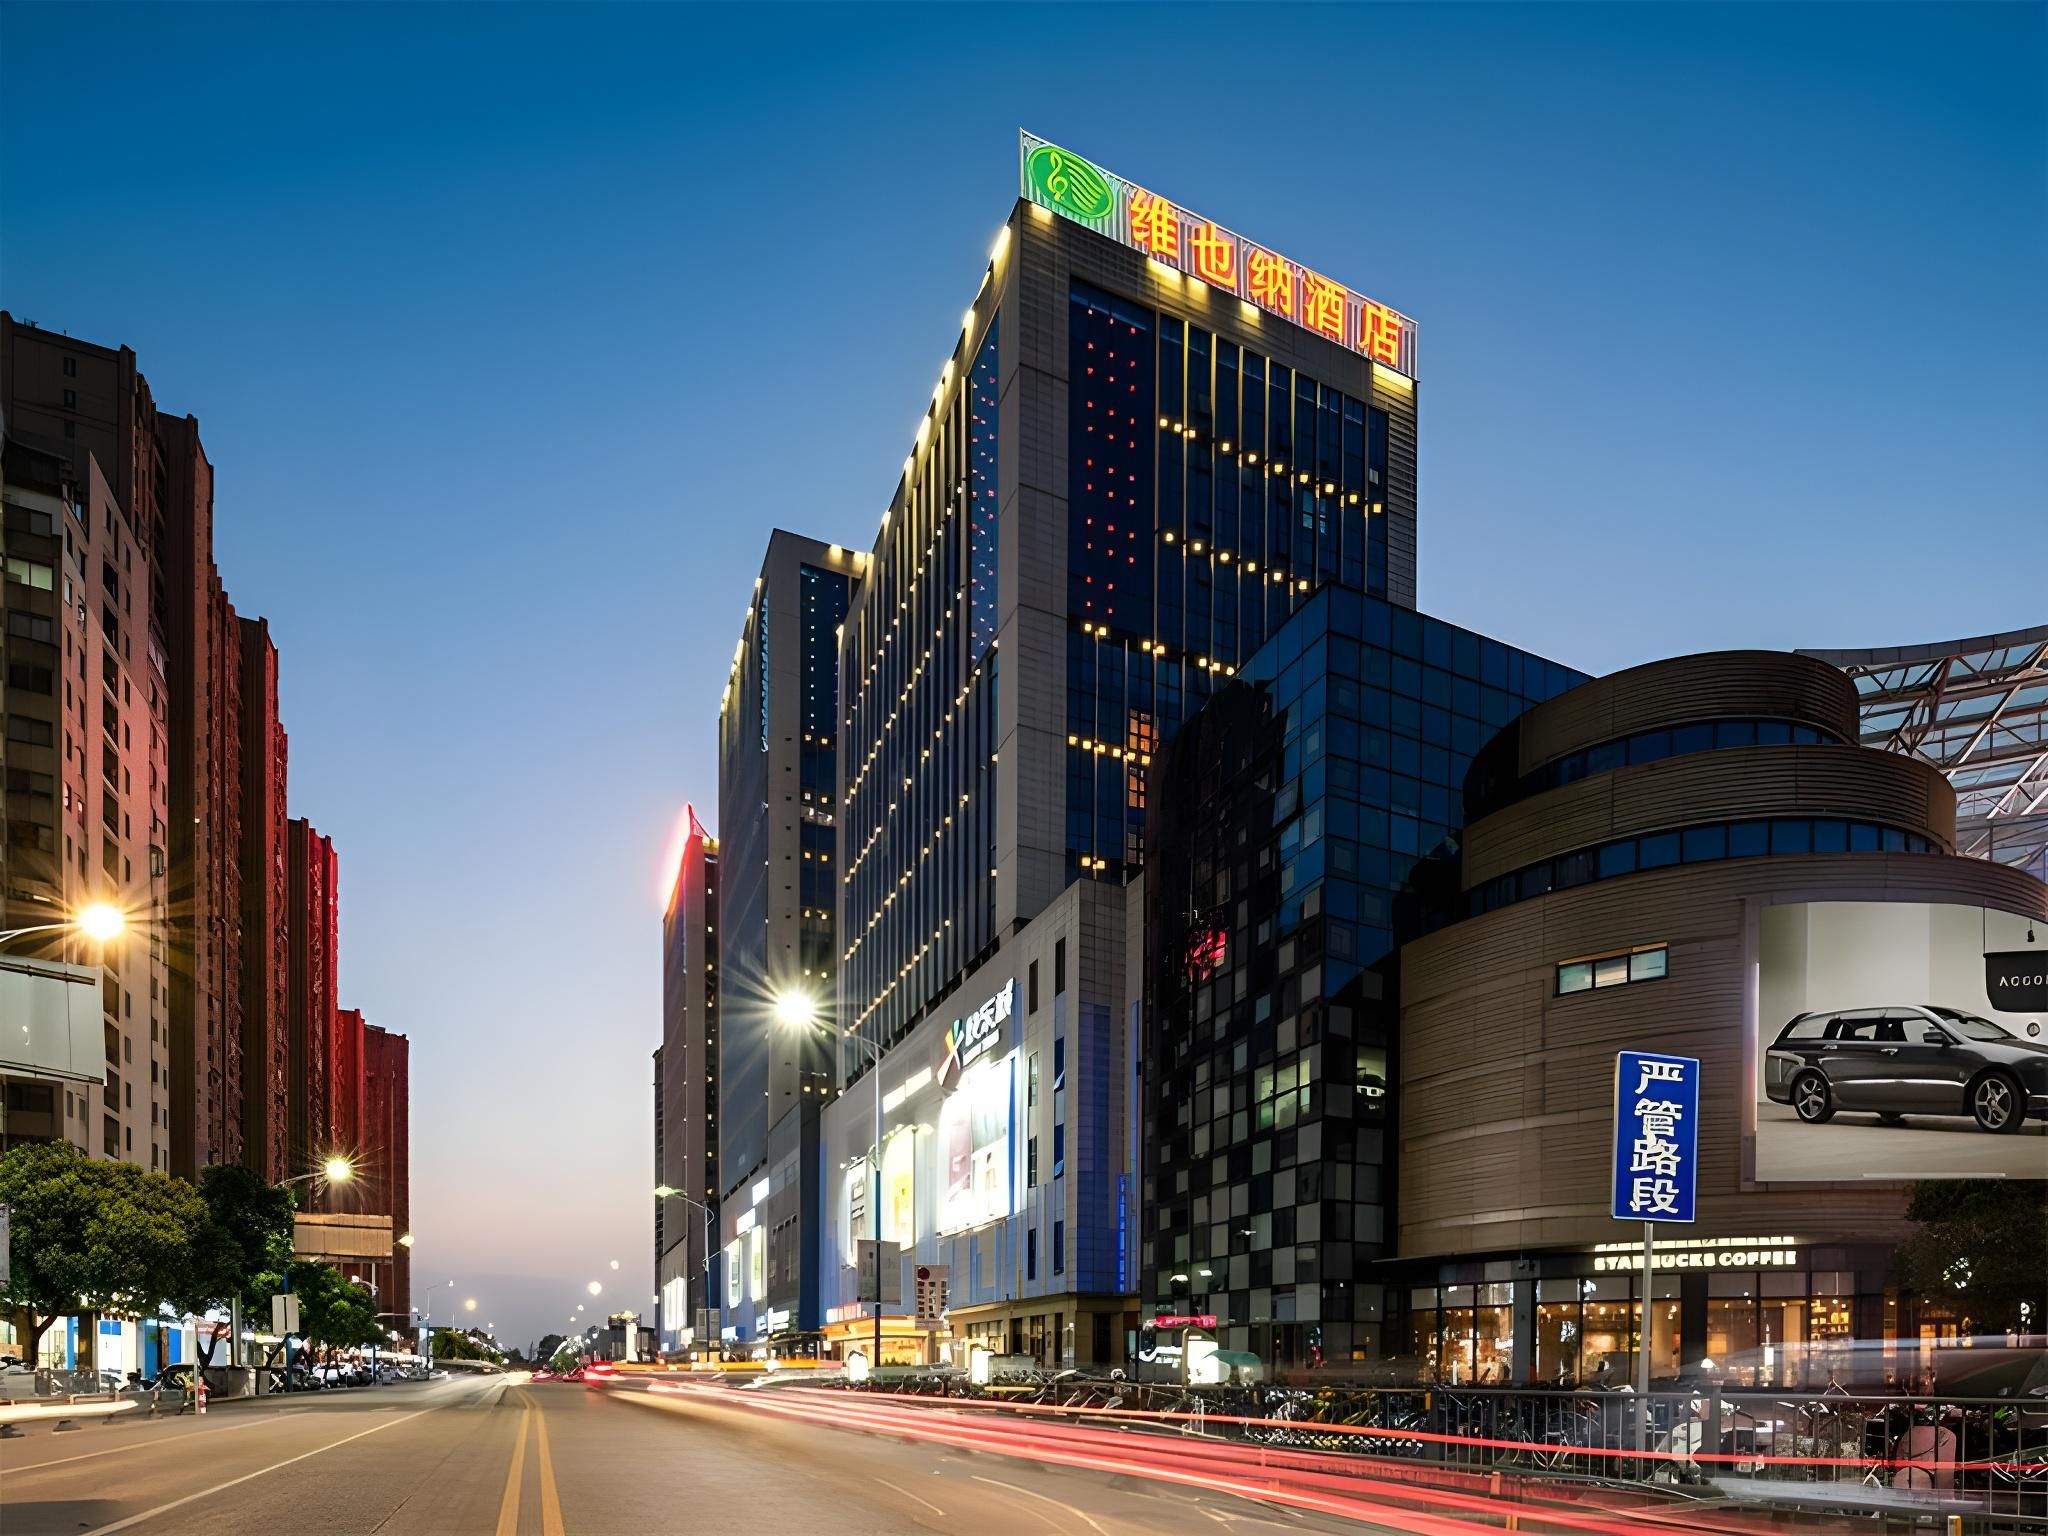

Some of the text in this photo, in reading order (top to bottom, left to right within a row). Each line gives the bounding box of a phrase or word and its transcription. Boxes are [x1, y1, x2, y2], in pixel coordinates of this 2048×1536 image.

[1130, 189, 1402, 367] 维也纳酒店
[1630, 1060, 1684, 1213] 严管路段
[1718, 1251, 1797, 1266] COFFEE
